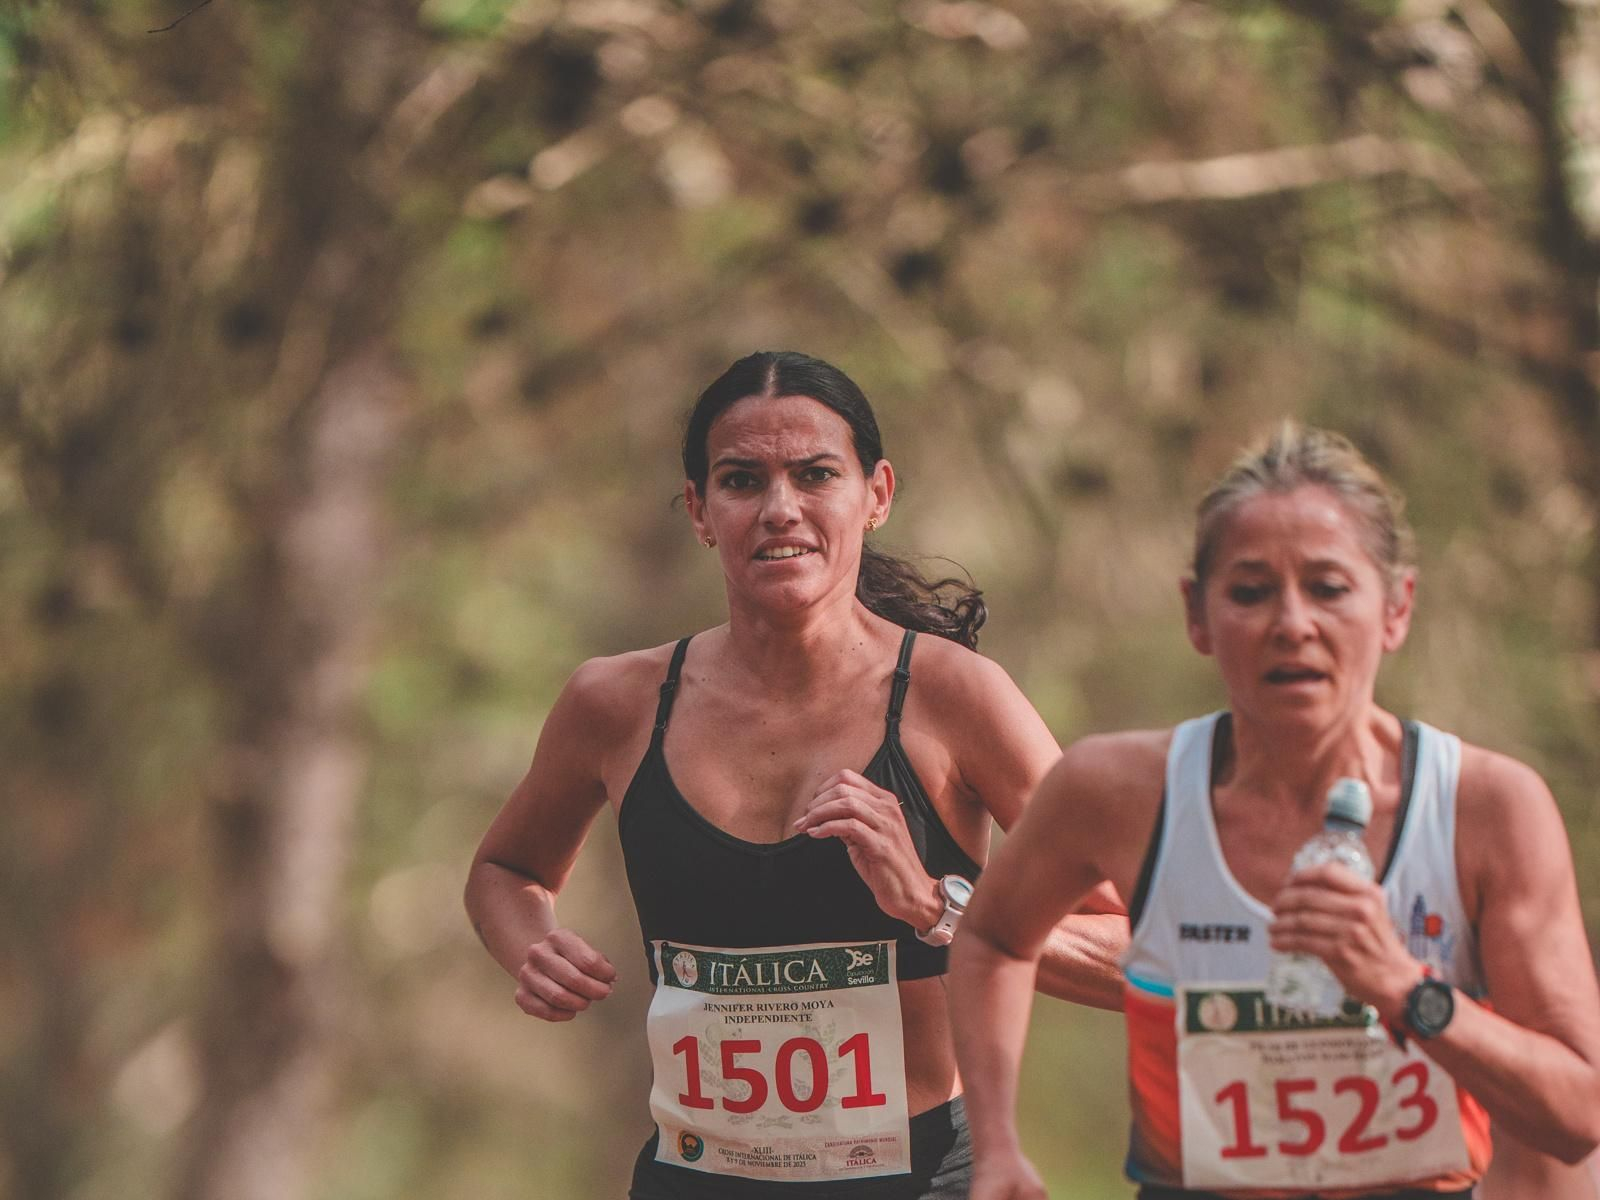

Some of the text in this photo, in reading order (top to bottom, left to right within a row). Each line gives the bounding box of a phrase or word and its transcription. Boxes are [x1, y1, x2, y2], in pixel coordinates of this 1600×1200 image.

[709, 958, 828, 987] ITÁLICA
[847, 975, 875, 986] Sevilla
[793, 983, 829, 992] COUNTRY
[703, 1000, 834, 1012] JENNIFER RIVERO MOYA
[724, 1013, 813, 1024] INDEPENDIENTE
[673, 1033, 887, 1114] 1501
[1214, 1061, 1439, 1159] 1523
